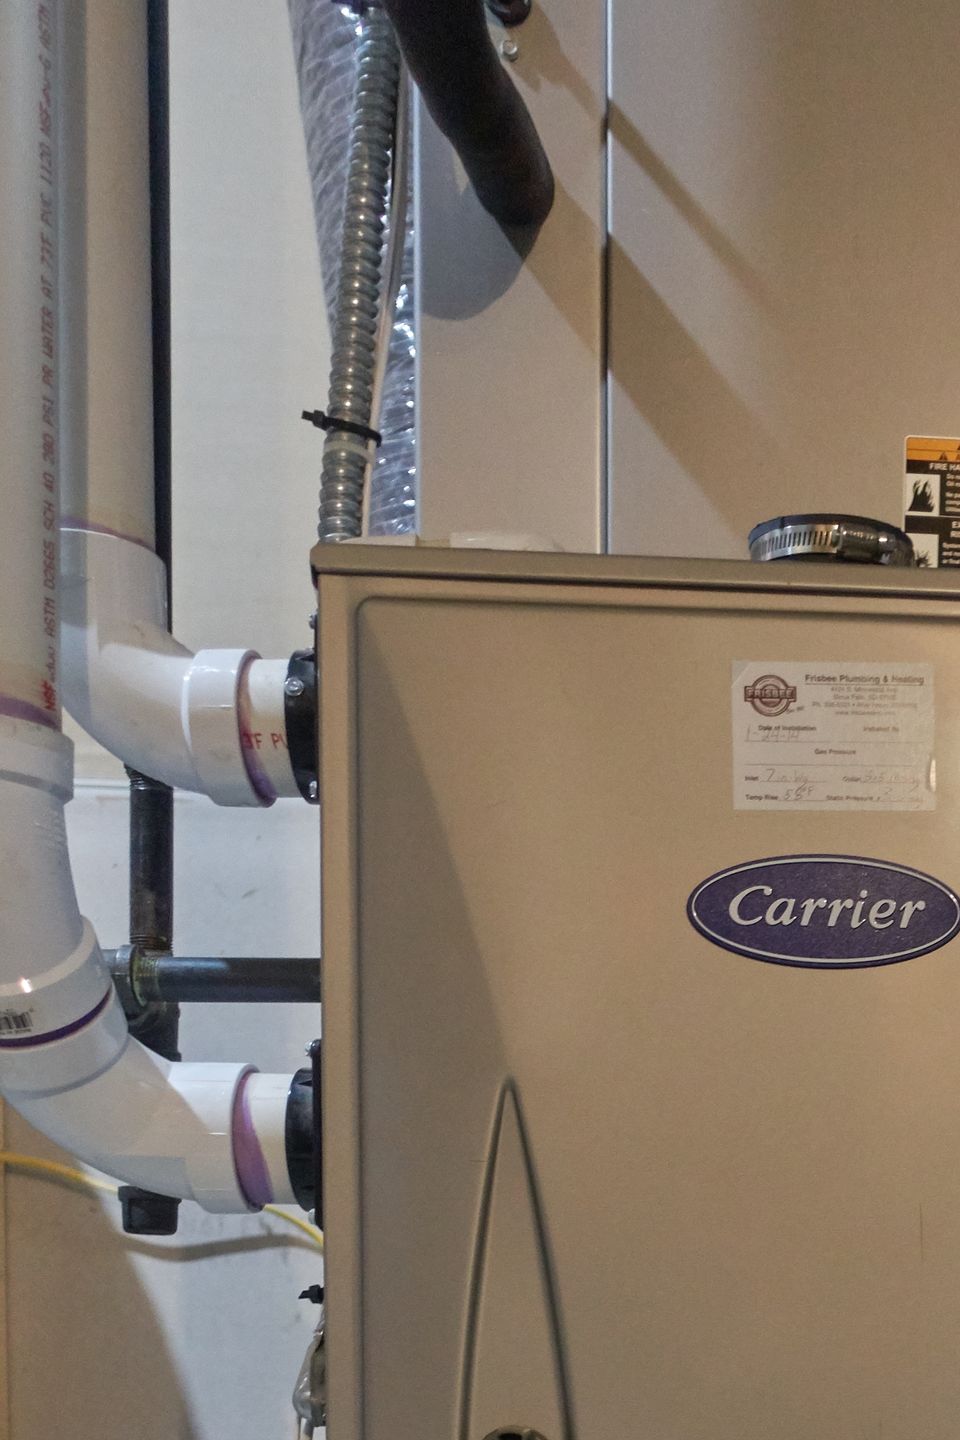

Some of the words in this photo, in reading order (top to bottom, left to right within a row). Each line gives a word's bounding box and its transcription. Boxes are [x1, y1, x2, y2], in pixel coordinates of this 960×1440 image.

[40, 275, 53, 300] AT
[40, 306, 53, 359] WATER
[42, 364, 54, 388] PR
[42, 396, 54, 427] PSI
[930, 463, 947, 471] FIRE
[42, 471, 54, 493] 40
[43, 499, 54, 531] SCH
[42, 539, 54, 589] D2665
[44, 597, 55, 637] ASTM
[746, 689, 793, 697] FRISBEE
[804, 674, 837, 683] Frisbee
[839, 674, 880, 684] Plumbing
[882, 675, 887, 684] &
[728, 884, 926, 929] Carrier
